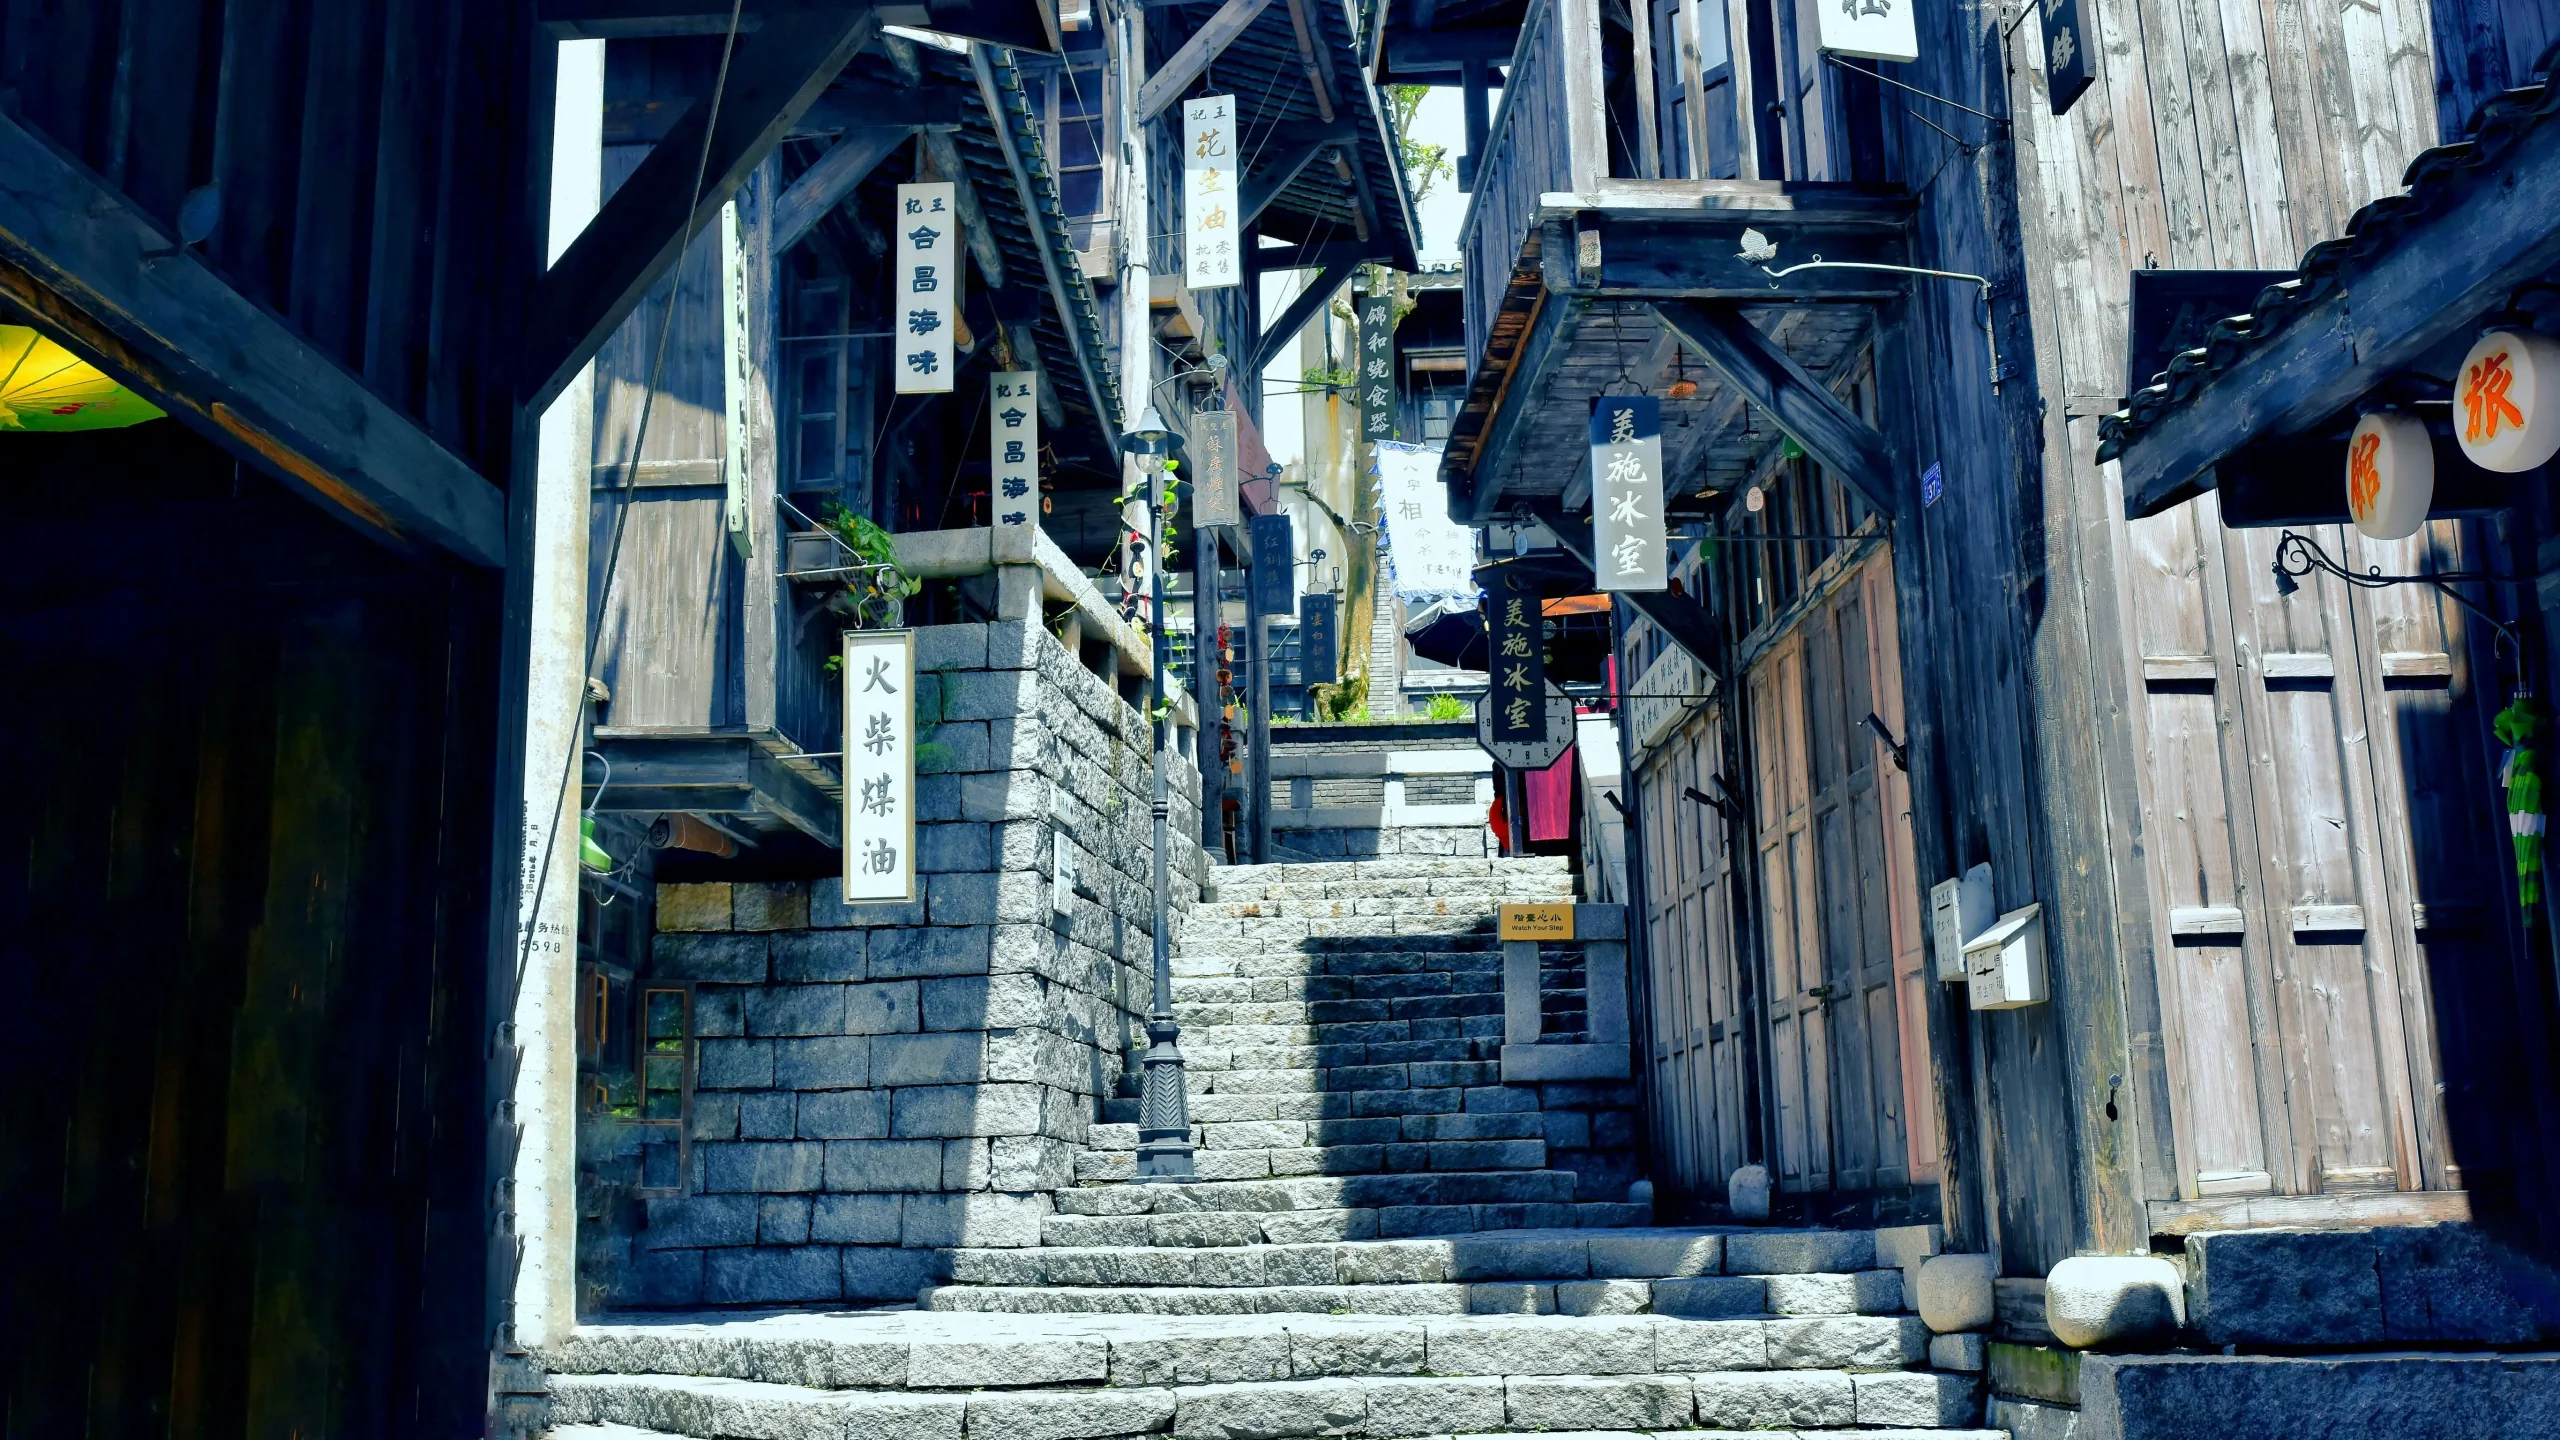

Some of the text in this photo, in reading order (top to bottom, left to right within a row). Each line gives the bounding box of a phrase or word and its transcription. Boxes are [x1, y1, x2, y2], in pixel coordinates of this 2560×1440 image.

[1196, 128, 1228, 232] 花生油
[907, 225, 941, 375] 合昌海味
[2463, 352, 2525, 443] 旅
[1000, 406, 1030, 526] 合昌海味
[1398, 498, 1423, 521] 相
[1605, 408, 1650, 576] 美施冰室
[1500, 598, 1533, 730] 美施冰室
[860, 655, 898, 876] 火柴煤油
[1549, 924, 1564, 932] Step
